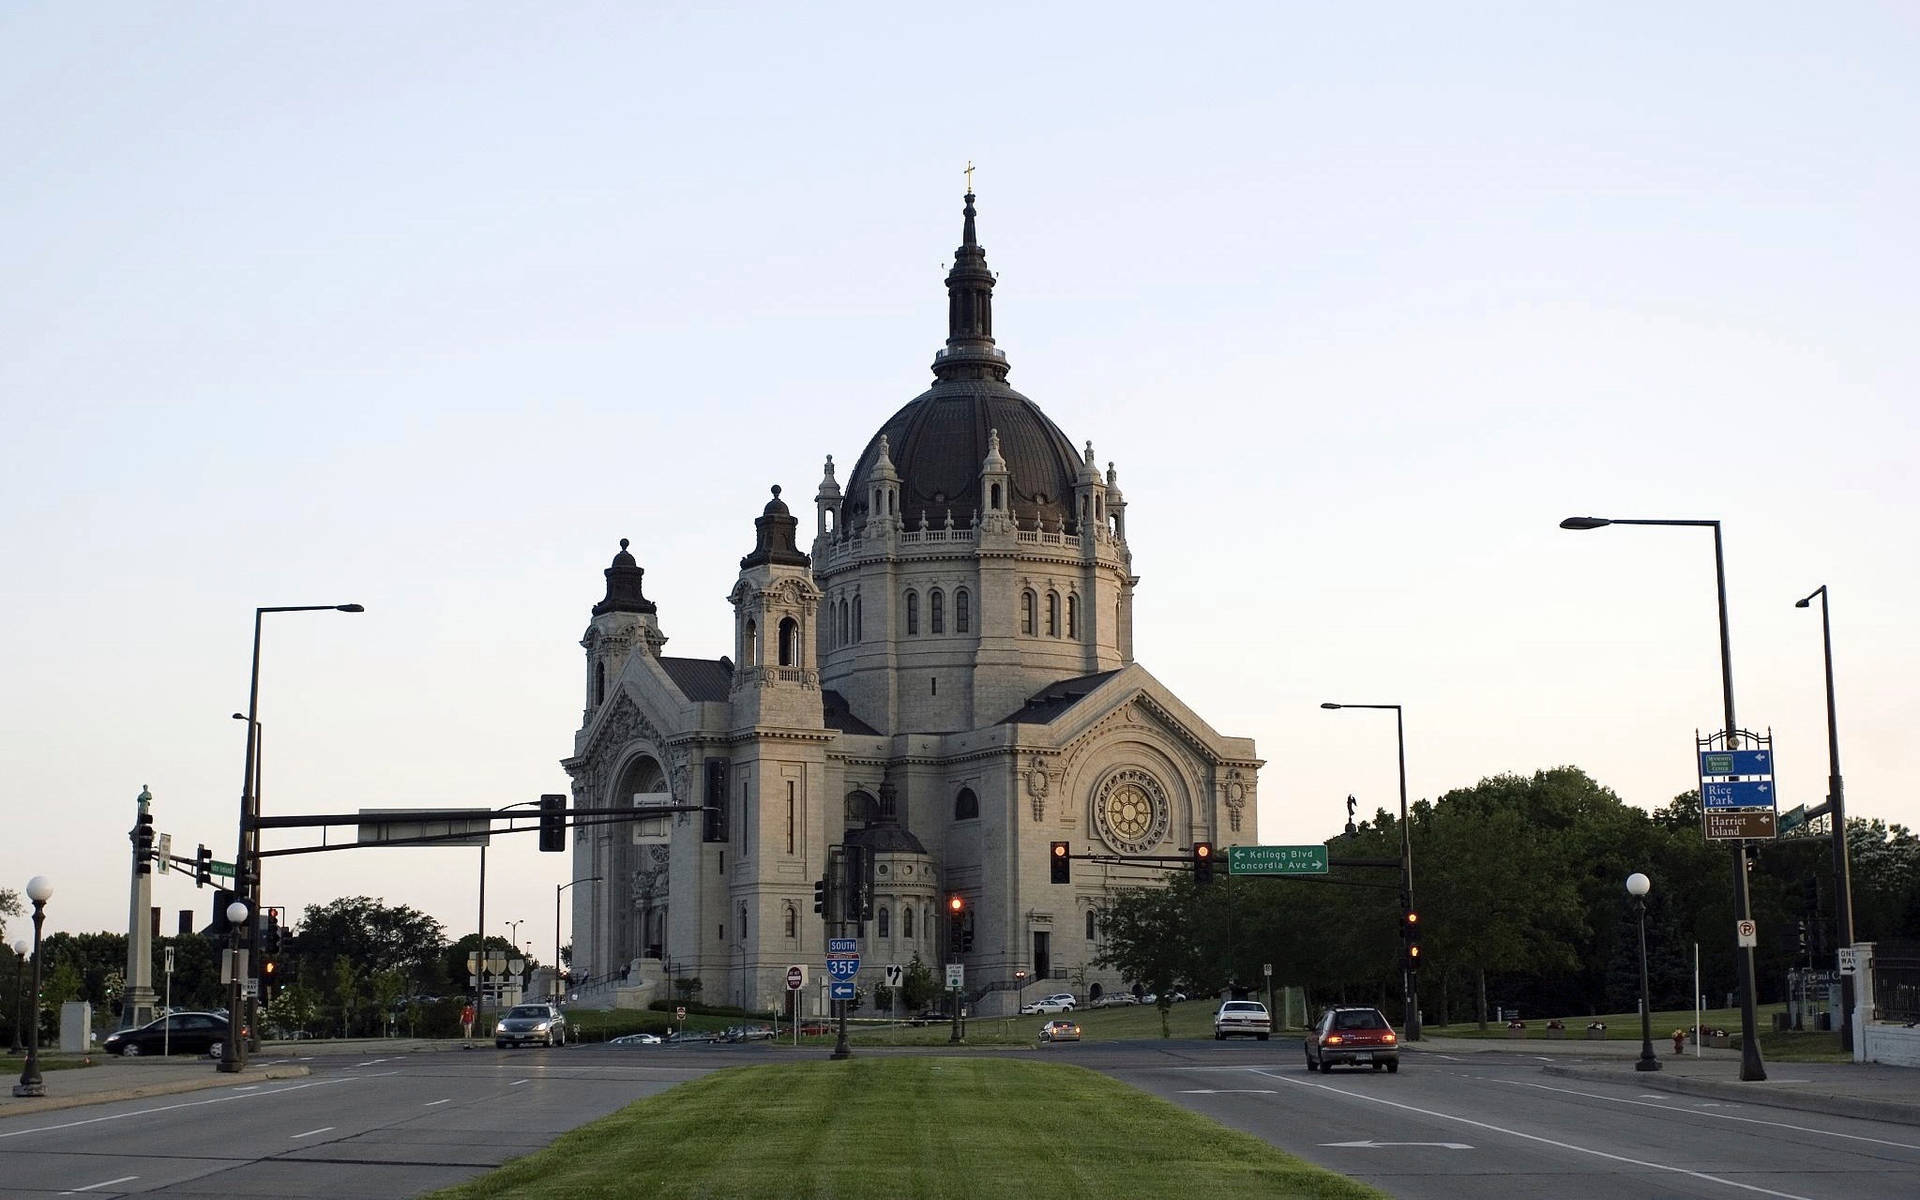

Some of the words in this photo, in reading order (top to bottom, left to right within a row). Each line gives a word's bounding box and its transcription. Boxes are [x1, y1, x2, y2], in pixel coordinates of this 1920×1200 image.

[1708, 785, 1732, 795] Rice
[1709, 795, 1734, 805] Park
[1710, 816, 1746, 826] Harriet
[1711, 826, 1740, 836] Island
[1249, 850, 1286, 860] Kellogg
[1291, 850, 1313, 858] Blvd
[1233, 862, 1283, 870] Concordia
[1288, 861, 1307, 869] Ave
[831, 941, 856, 950] SOUTH
[830, 961, 855, 974] 35E
